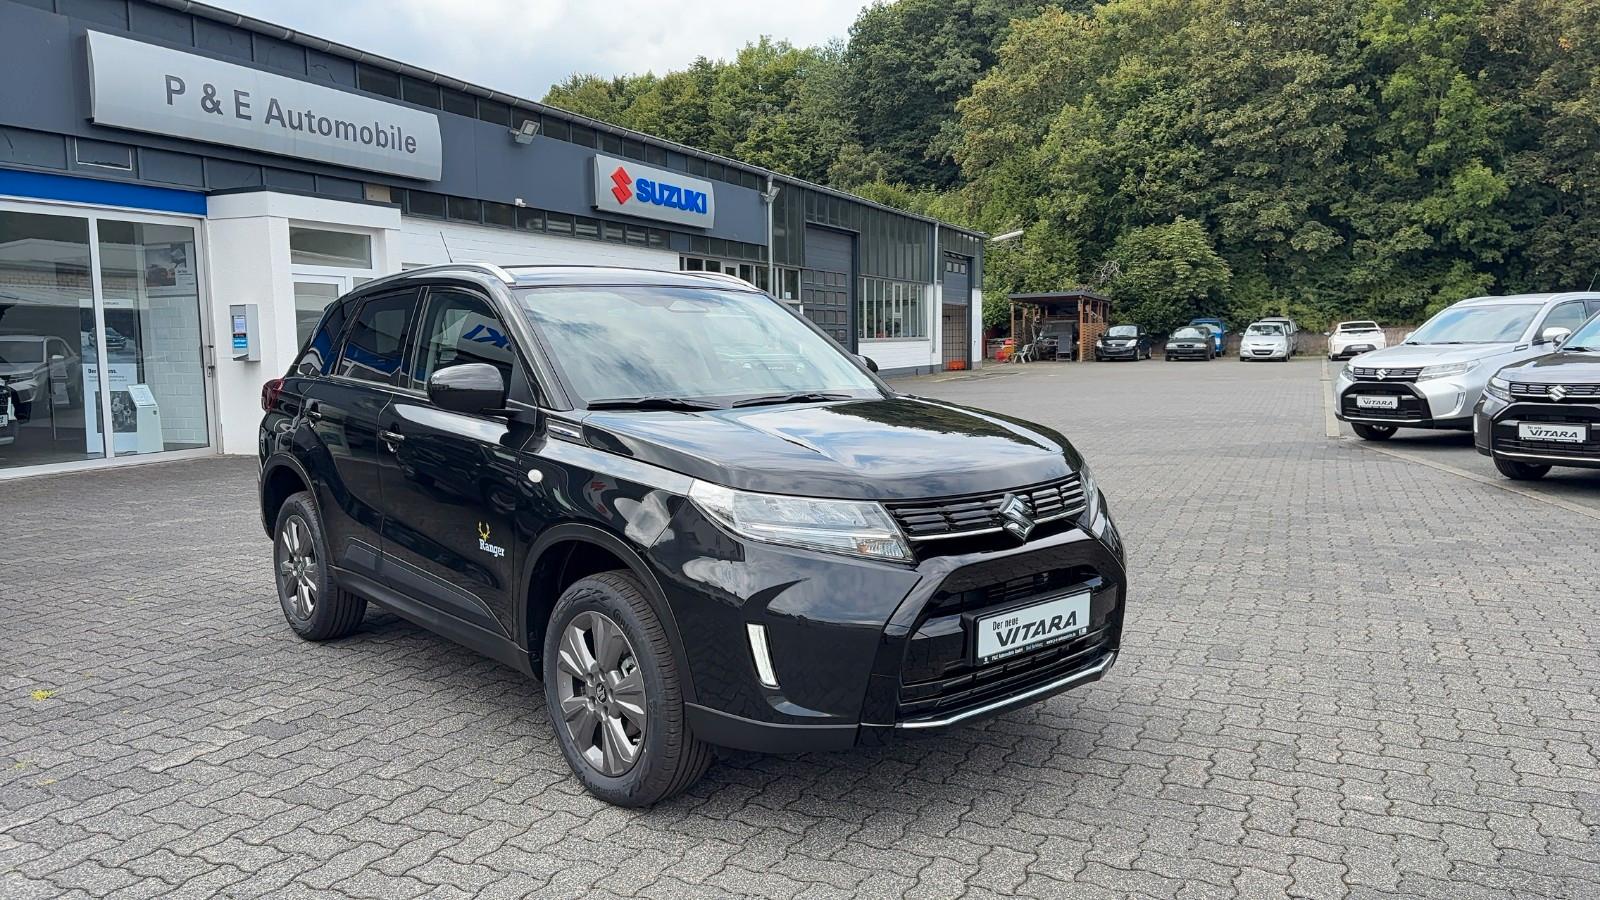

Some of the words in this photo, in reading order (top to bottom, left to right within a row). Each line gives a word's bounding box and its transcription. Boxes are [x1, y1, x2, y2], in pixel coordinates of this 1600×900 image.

[164, 74, 186, 106] P
[200, 83, 224, 116] &
[233, 89, 252, 121] E
[264, 97, 417, 153] Automobile
[635, 178, 707, 215] SUZUKI
[1529, 429, 1578, 438] VITARA
[479, 538, 505, 557] Ranger
[992, 620, 1003, 631] Der
[1004, 617, 1019, 627] neue
[995, 610, 1077, 647] VITARA
